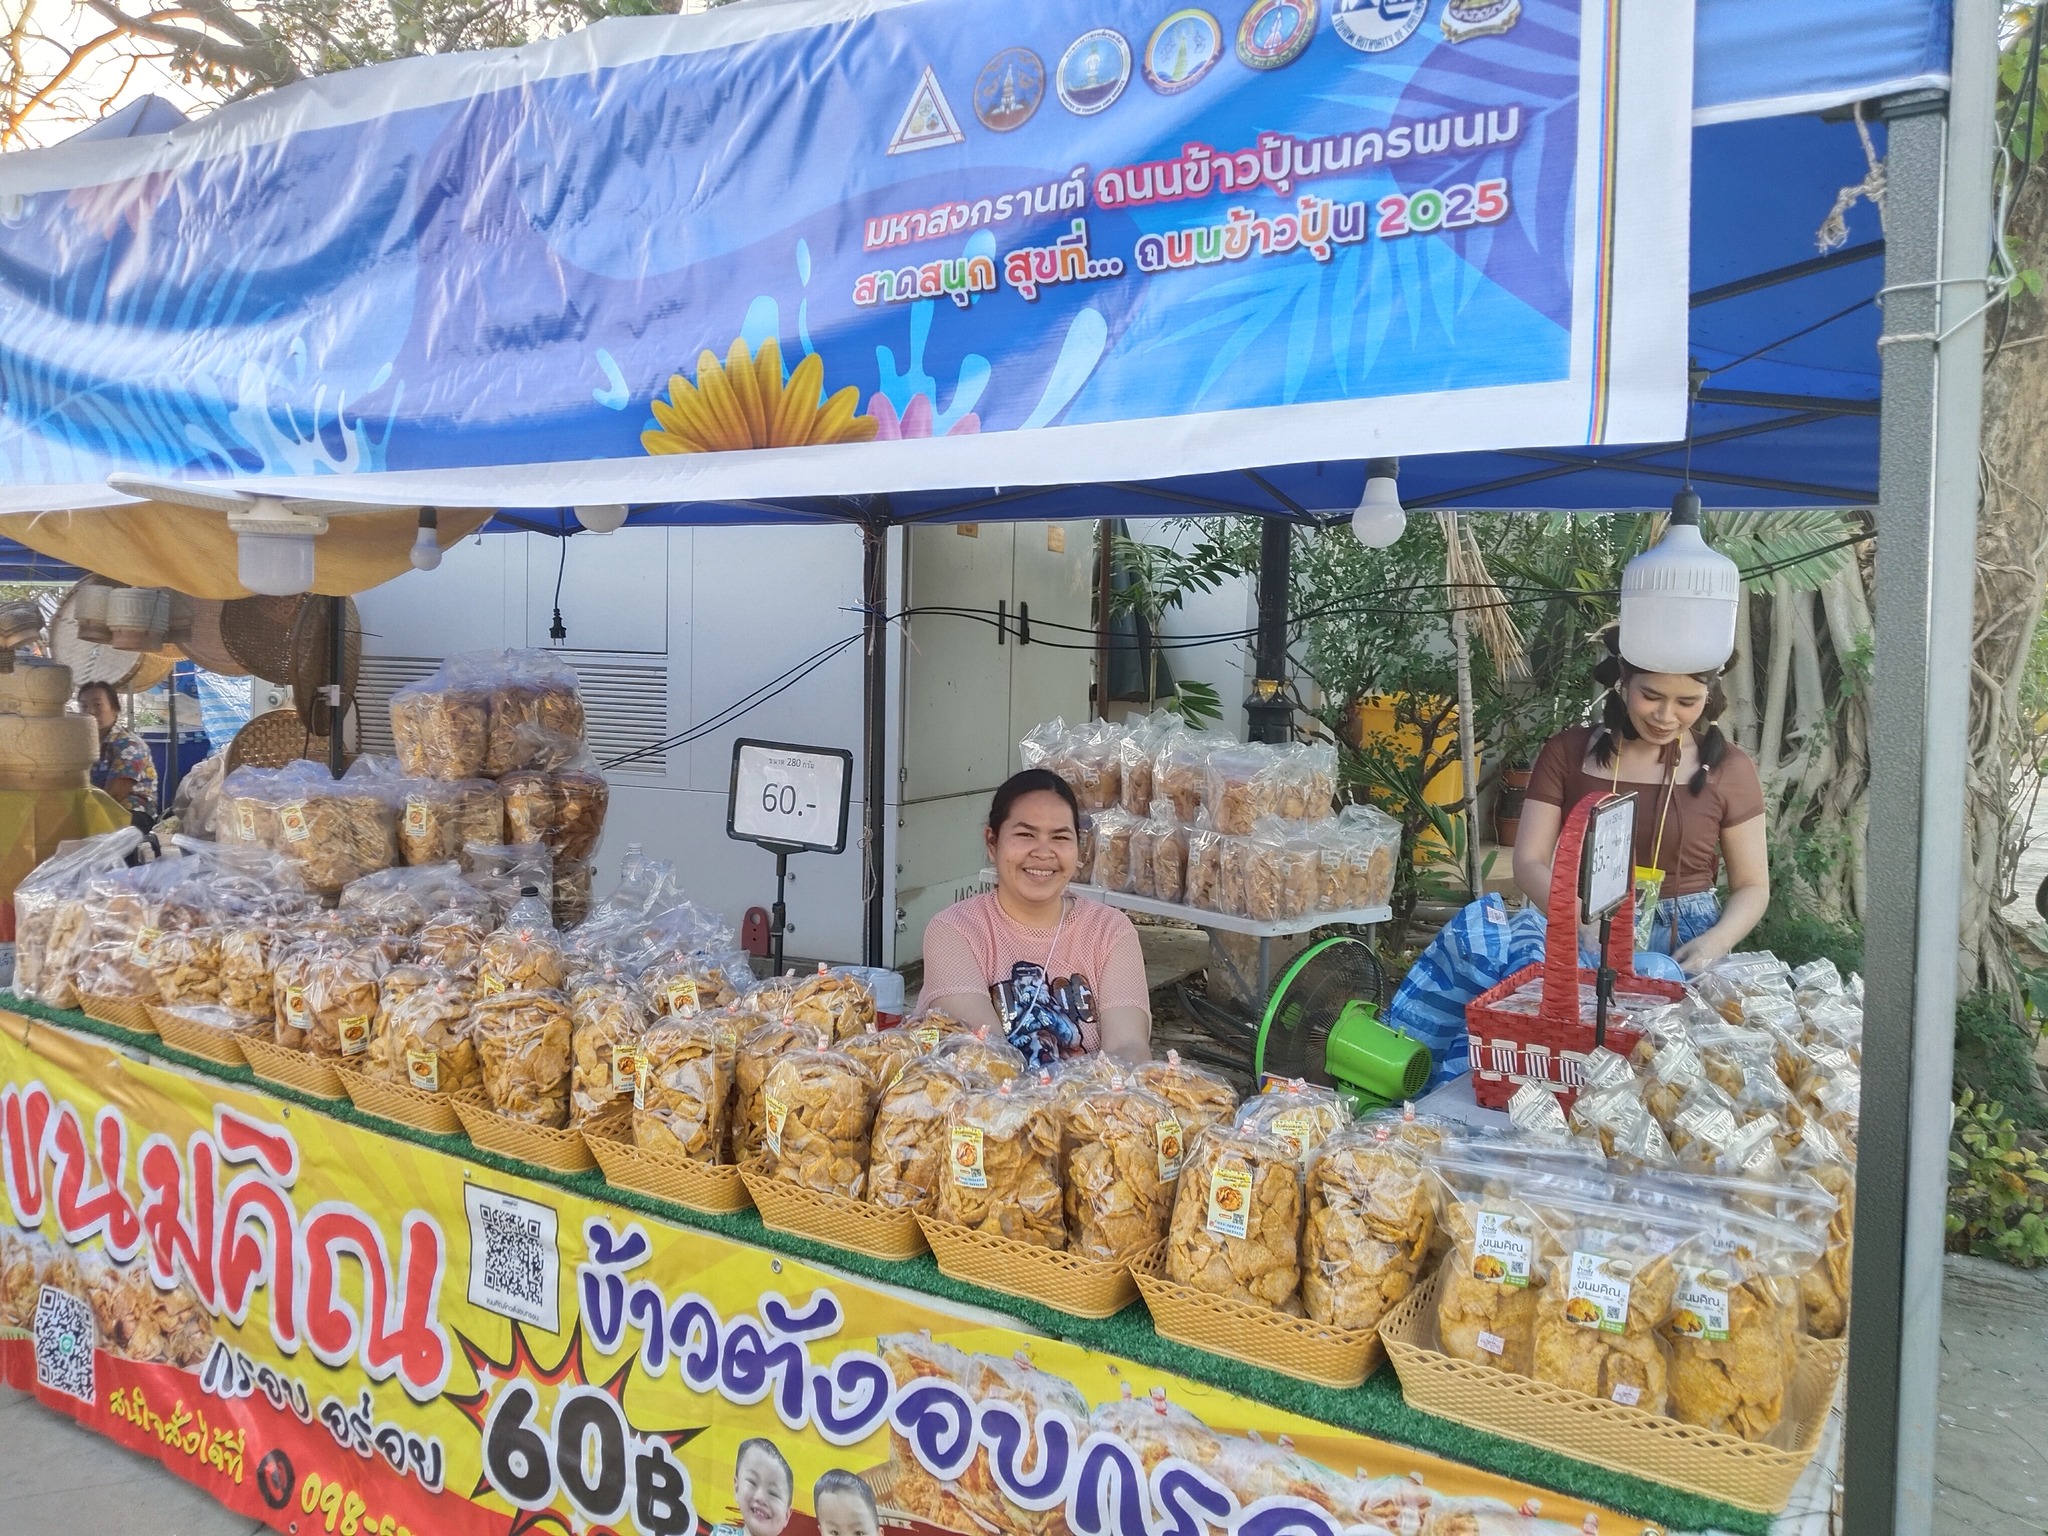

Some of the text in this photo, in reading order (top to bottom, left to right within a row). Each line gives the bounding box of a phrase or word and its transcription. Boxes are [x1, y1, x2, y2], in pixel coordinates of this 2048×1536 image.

[865, 105, 1520, 250] มหาสงกรานต์ ถนนข้าวปุ้นนครพนม
[854, 180, 1509, 306] สาดสนุก สุขที่... ถนนข้าวปุ้น 2025
[786, 757, 802, 768] 280
[762, 783, 817, 817] 60.-
[4, 1085, 448, 1394] ขนมคิณ
[1482, 1238, 1524, 1253] ขนมคิณ
[1577, 1280, 1621, 1298] ขนมคิณ
[1678, 1291, 1720, 1307] ขนมคิณ
[109, 1386, 247, 1485] สนใจสั่งได้ที่
[203, 1341, 444, 1490] กรอบ อร่อย
